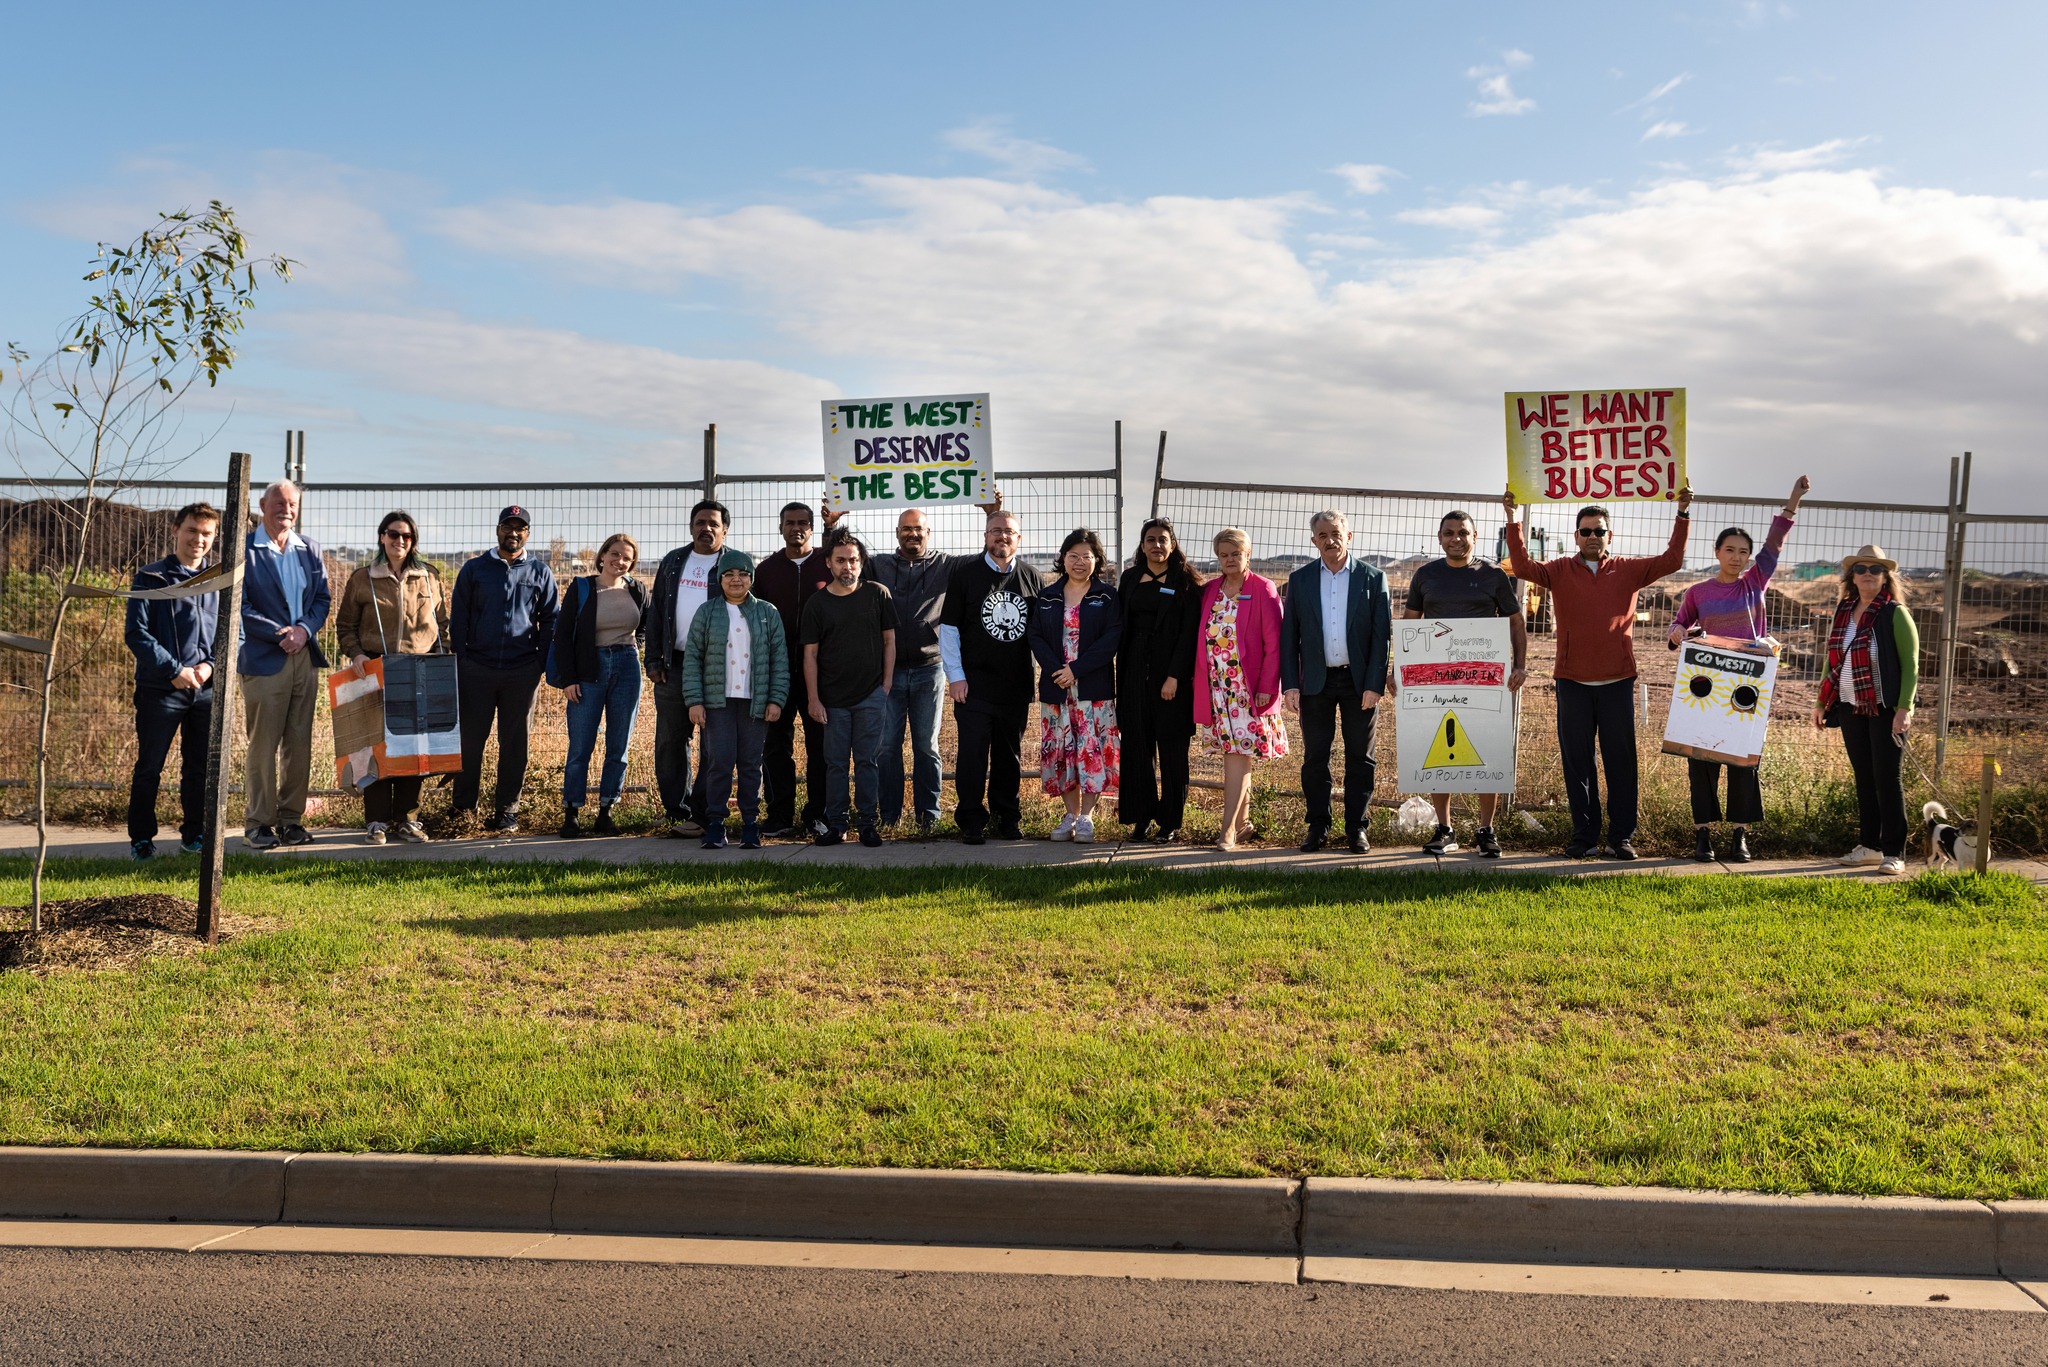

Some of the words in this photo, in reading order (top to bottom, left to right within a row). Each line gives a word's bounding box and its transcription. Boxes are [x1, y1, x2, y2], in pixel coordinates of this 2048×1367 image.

[838, 402, 894, 429] THE
[904, 401, 974, 427] WEST
[1517, 394, 1569, 431] WE
[1582, 391, 1674, 425] WANT
[854, 432, 971, 465] DESERVES
[1540, 425, 1672, 464] BETTER
[840, 472, 895, 501] THE
[904, 469, 978, 500] BEST
[1544, 461, 1675, 500] BUSES!
[982, 592, 1011, 614] TOUGH
[1012, 596, 1028, 614] GUY
[982, 616, 1006, 640] BOOK
[1008, 616, 1027, 640] CLUB
[1694, 652, 1713, 664] GO
[1715, 656, 1755, 677] WEST!!
[1406, 692, 1424, 703] To:
[1432, 694, 1468, 705] Anywhere
[1414, 769, 1432, 782] NO
[1435, 769, 1472, 781] ROUTE
[1475, 770, 1505, 781] FOUND
